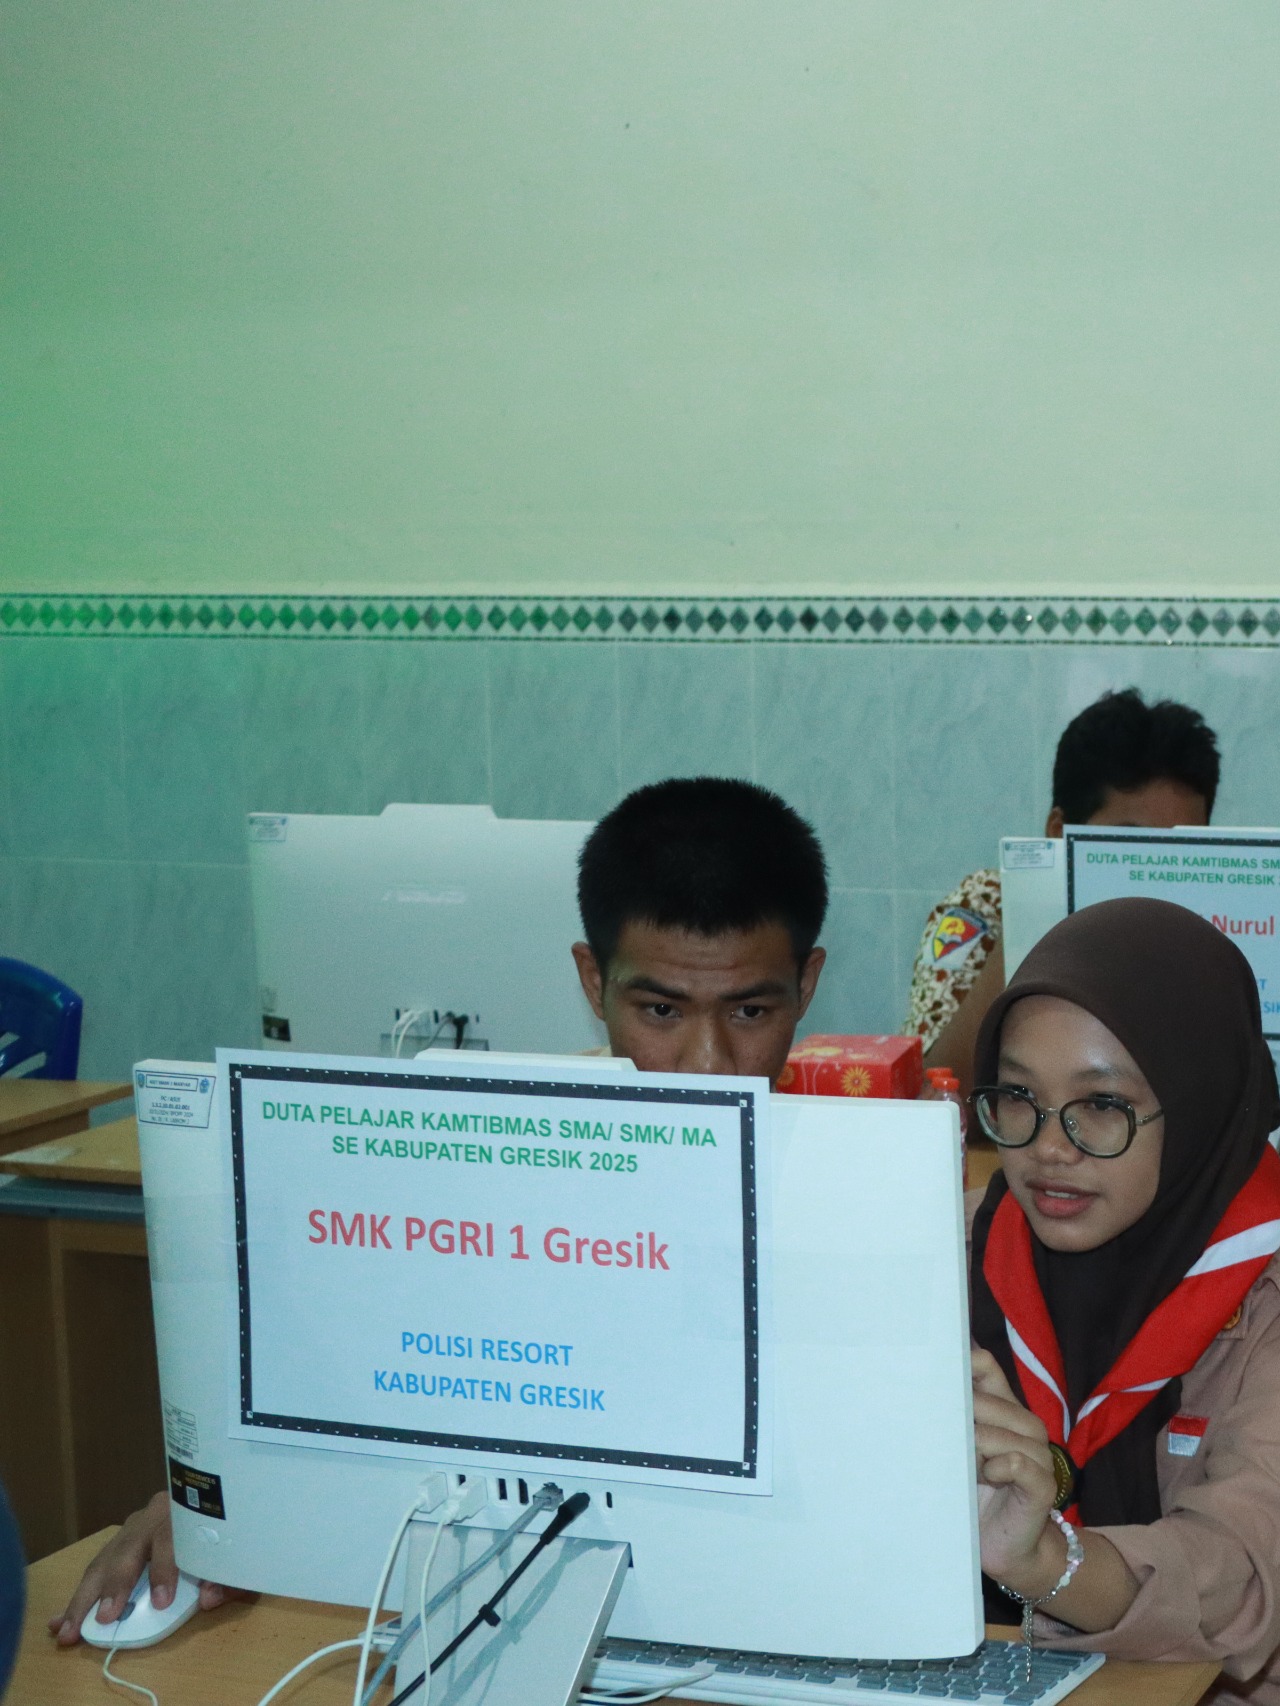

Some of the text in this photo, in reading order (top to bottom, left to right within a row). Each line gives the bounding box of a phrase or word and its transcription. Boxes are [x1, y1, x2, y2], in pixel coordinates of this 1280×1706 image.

[1086, 852, 1119, 865] DUTA
[1122, 854, 1179, 867] PELAJAR
[1182, 856, 1258, 869] KAMTIBMAS
[1128, 870, 1145, 882] SE
[1148, 871, 1224, 884] KABUPATEN
[1226, 873, 1275, 886] GRESIK
[1211, 914, 1275, 936] Nurul
[262, 1101, 718, 1148] DUTA PELAJAR KAMTIBMAS SMA/ SMK/ MA
[332, 1135, 639, 1173] SE KABUPATEN GRESIK 2025
[308, 1209, 671, 1271] SMK PGRI 1 Gresik
[401, 1331, 573, 1367] POLISI RESORT
[373, 1370, 605, 1412] KABUPATEN GRESIK
